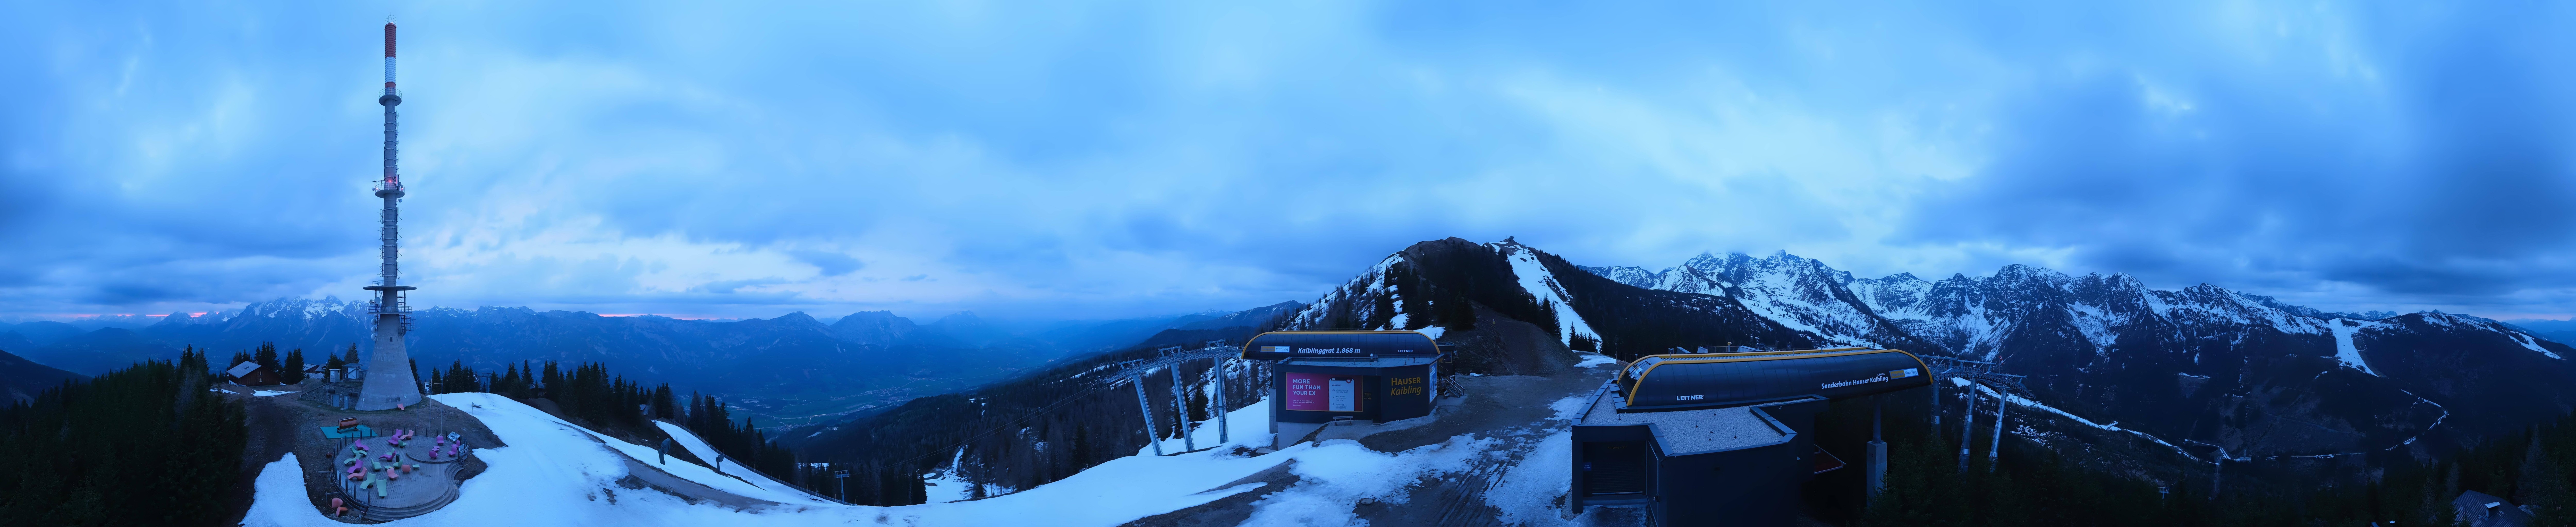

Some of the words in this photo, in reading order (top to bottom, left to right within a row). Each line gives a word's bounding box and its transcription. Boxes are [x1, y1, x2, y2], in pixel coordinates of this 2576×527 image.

[1391, 377, 1421, 386] HAUSER
[1821, 380, 1852, 389] Senderbahn
[1391, 386, 1421, 396] Kaibling
